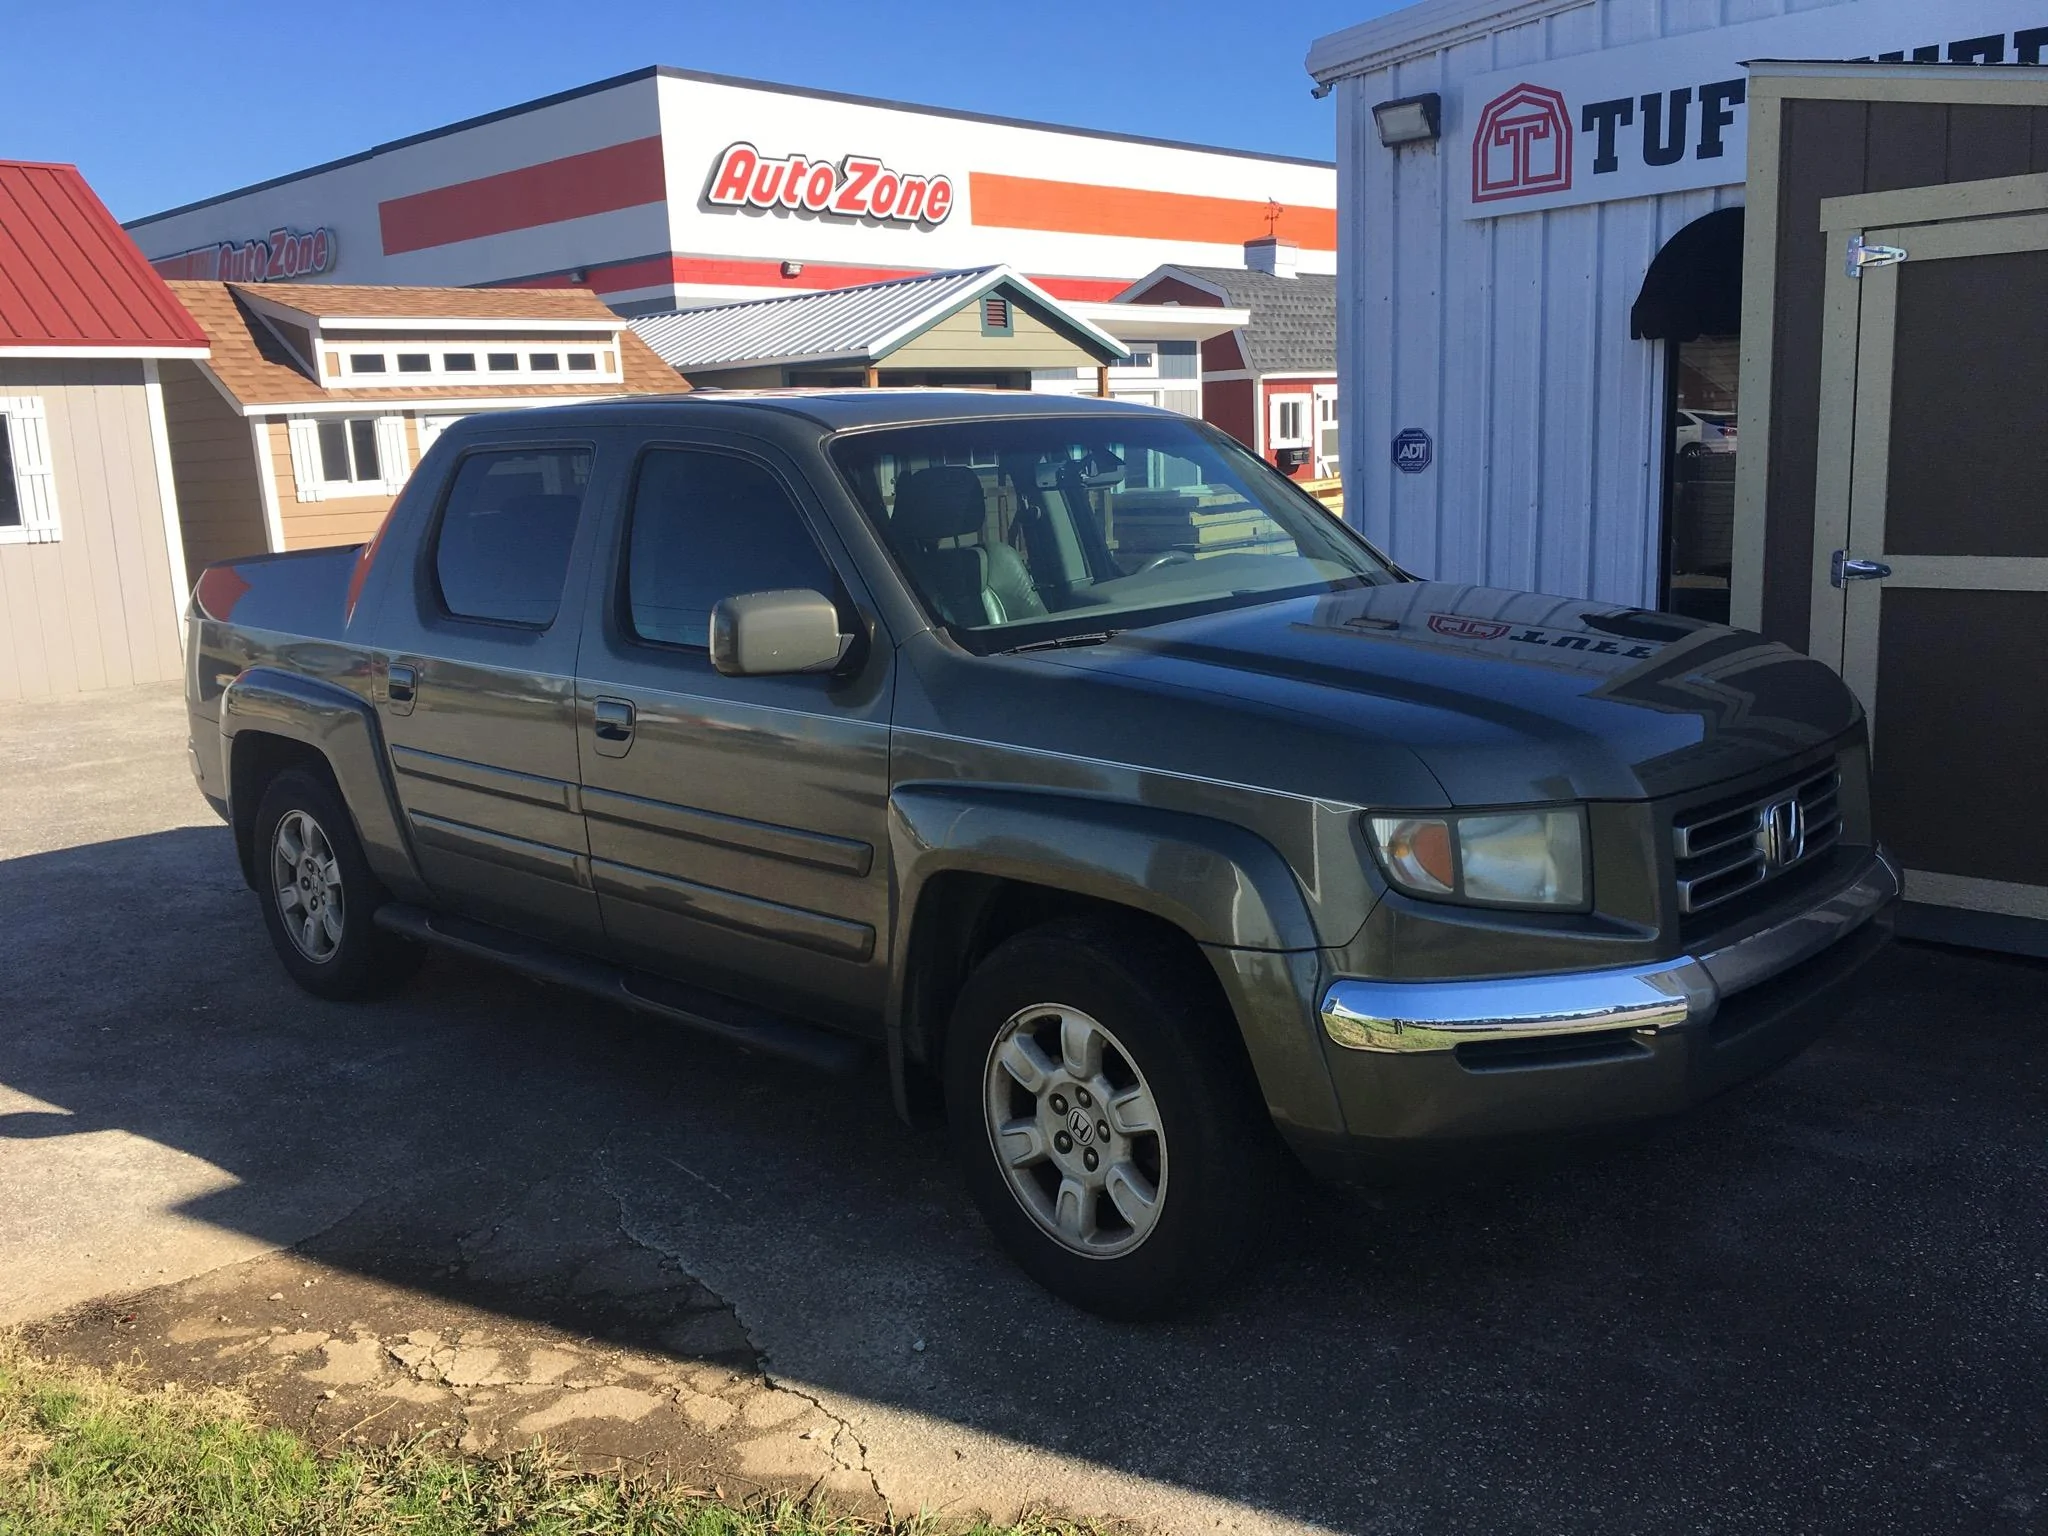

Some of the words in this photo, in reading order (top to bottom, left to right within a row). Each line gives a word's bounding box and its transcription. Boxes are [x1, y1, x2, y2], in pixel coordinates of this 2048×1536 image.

[1582, 78, 1746, 175] TUF
[710, 146, 952, 224] AutoZone
[217, 229, 328, 282] AutoZone
[1399, 443, 1426, 459] ADT
